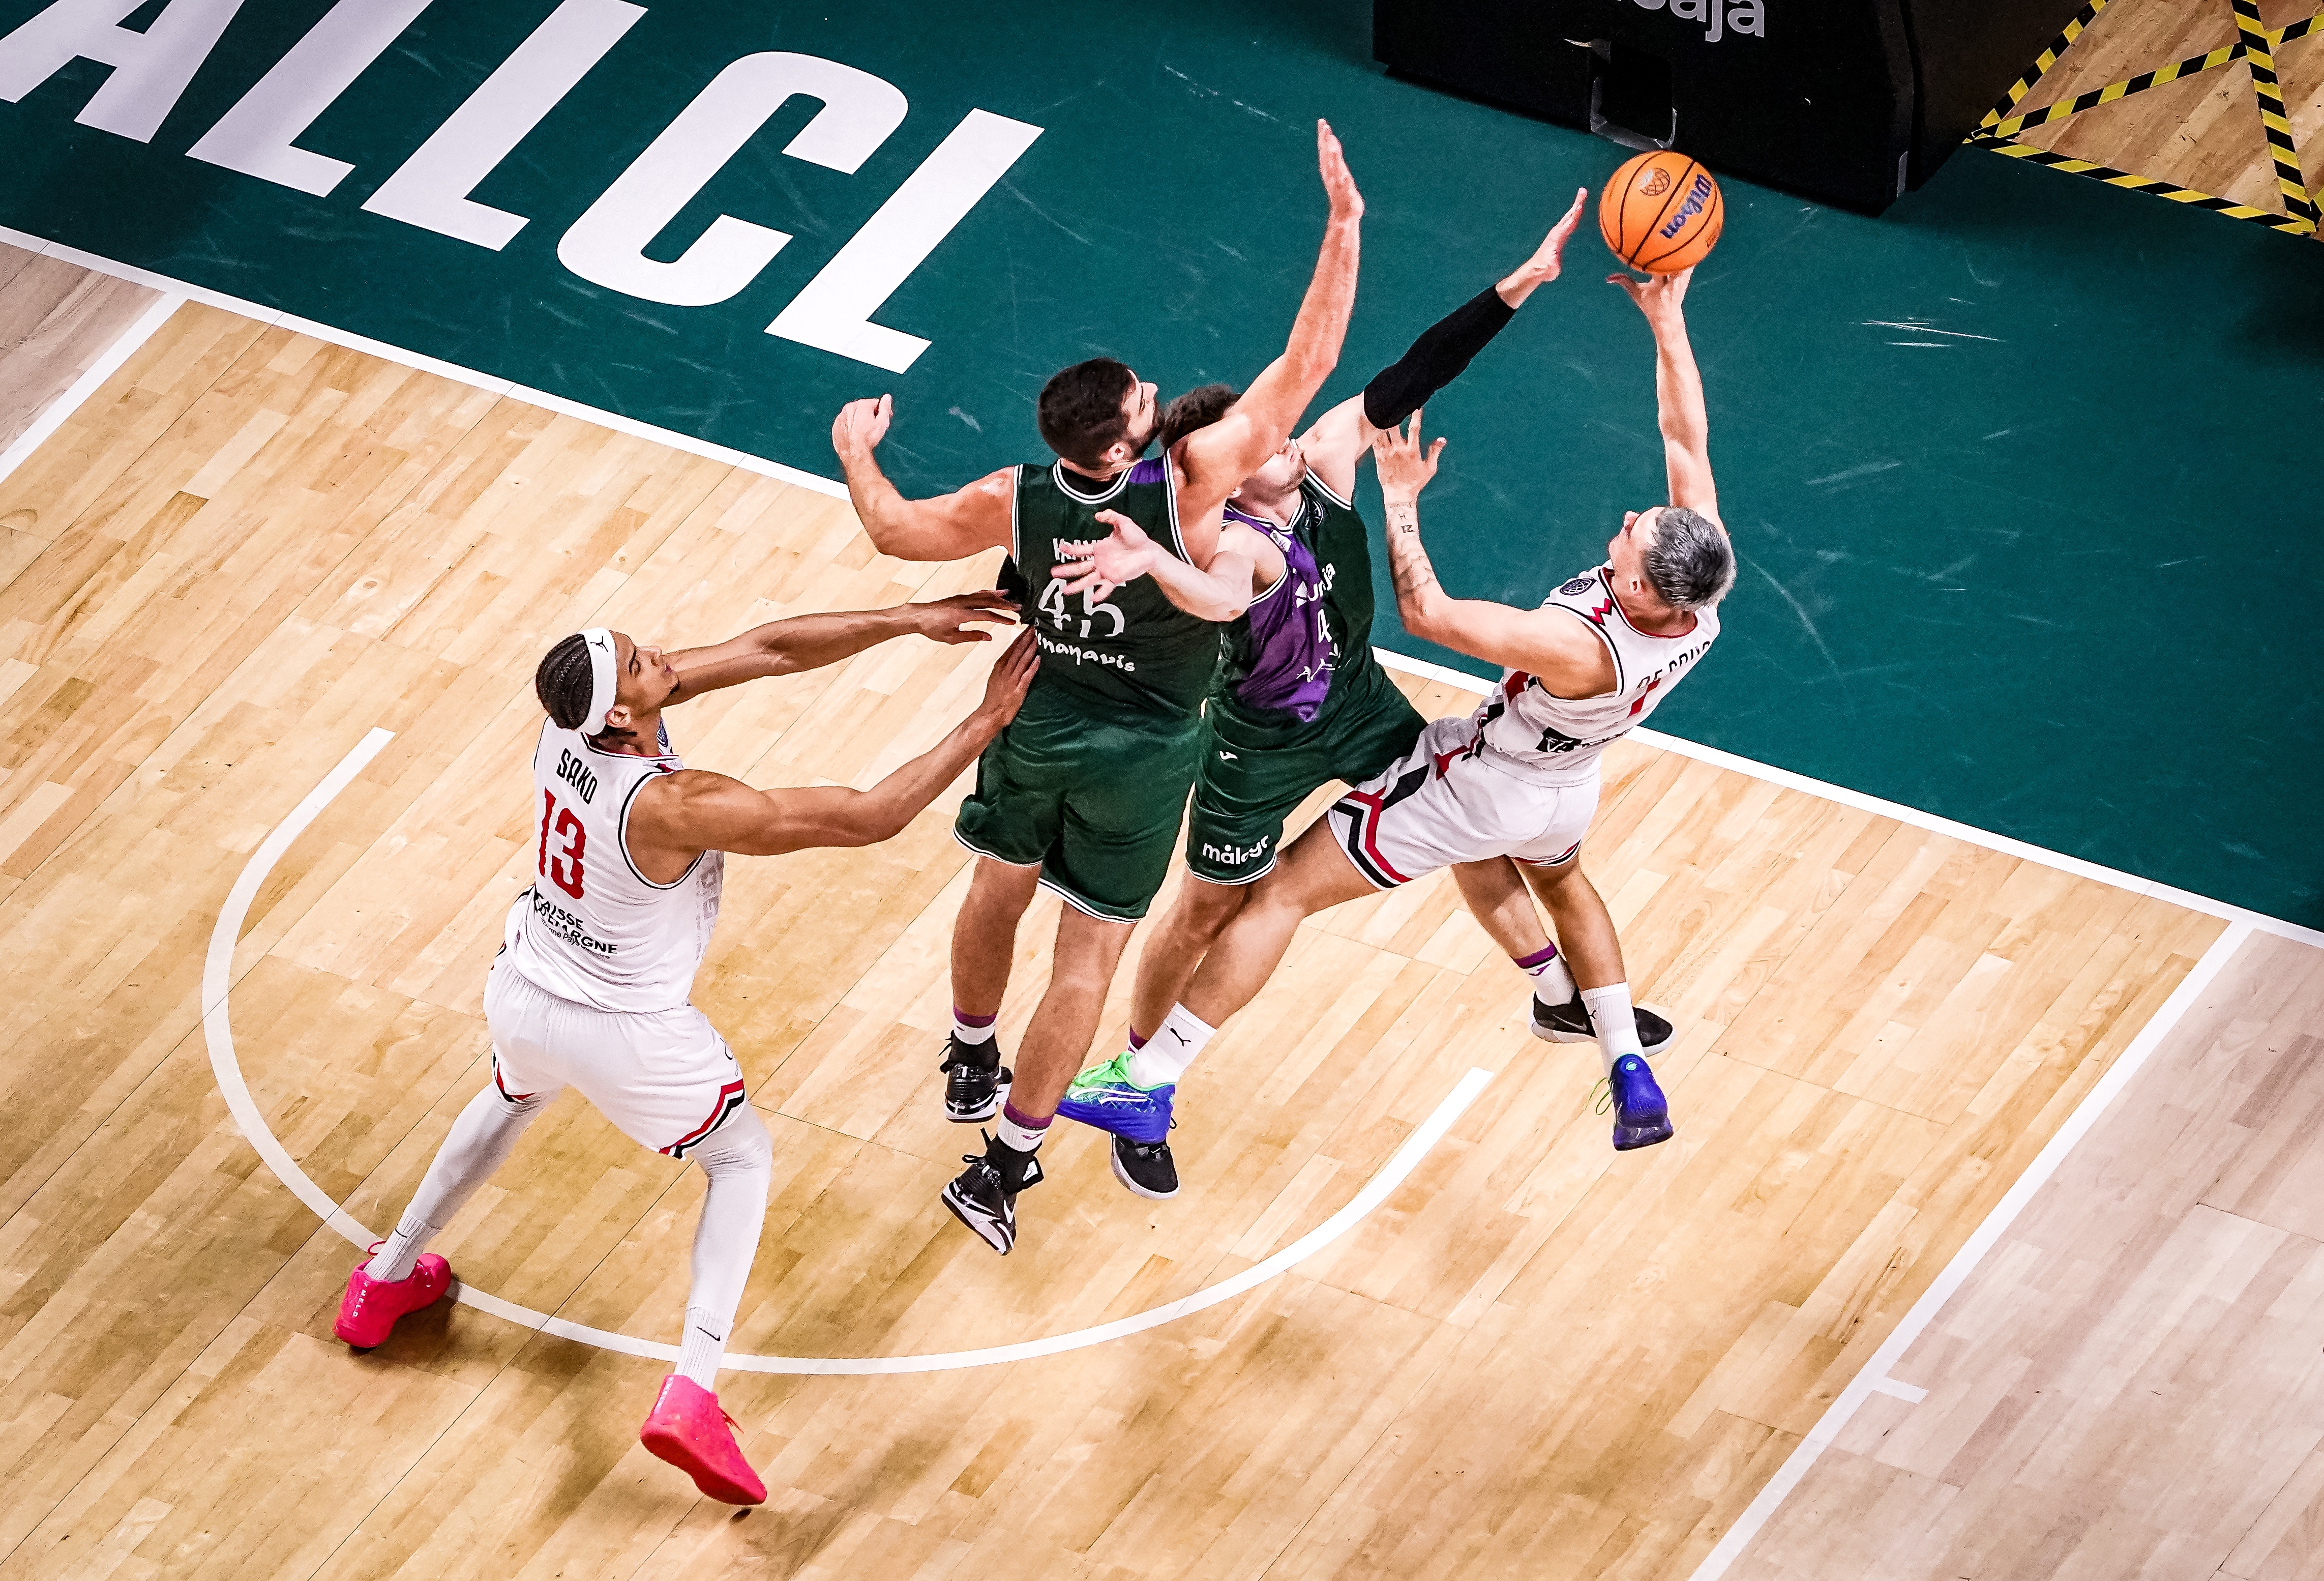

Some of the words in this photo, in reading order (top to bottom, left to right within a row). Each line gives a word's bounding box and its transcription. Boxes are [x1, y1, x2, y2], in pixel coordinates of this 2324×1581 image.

[1633, 0, 1765, 42] aja
[1660, 173, 1712, 239] Wilson
[1038, 578, 1125, 638] 45
[556, 748, 598, 805] SAKO
[539, 786, 586, 899] 13
